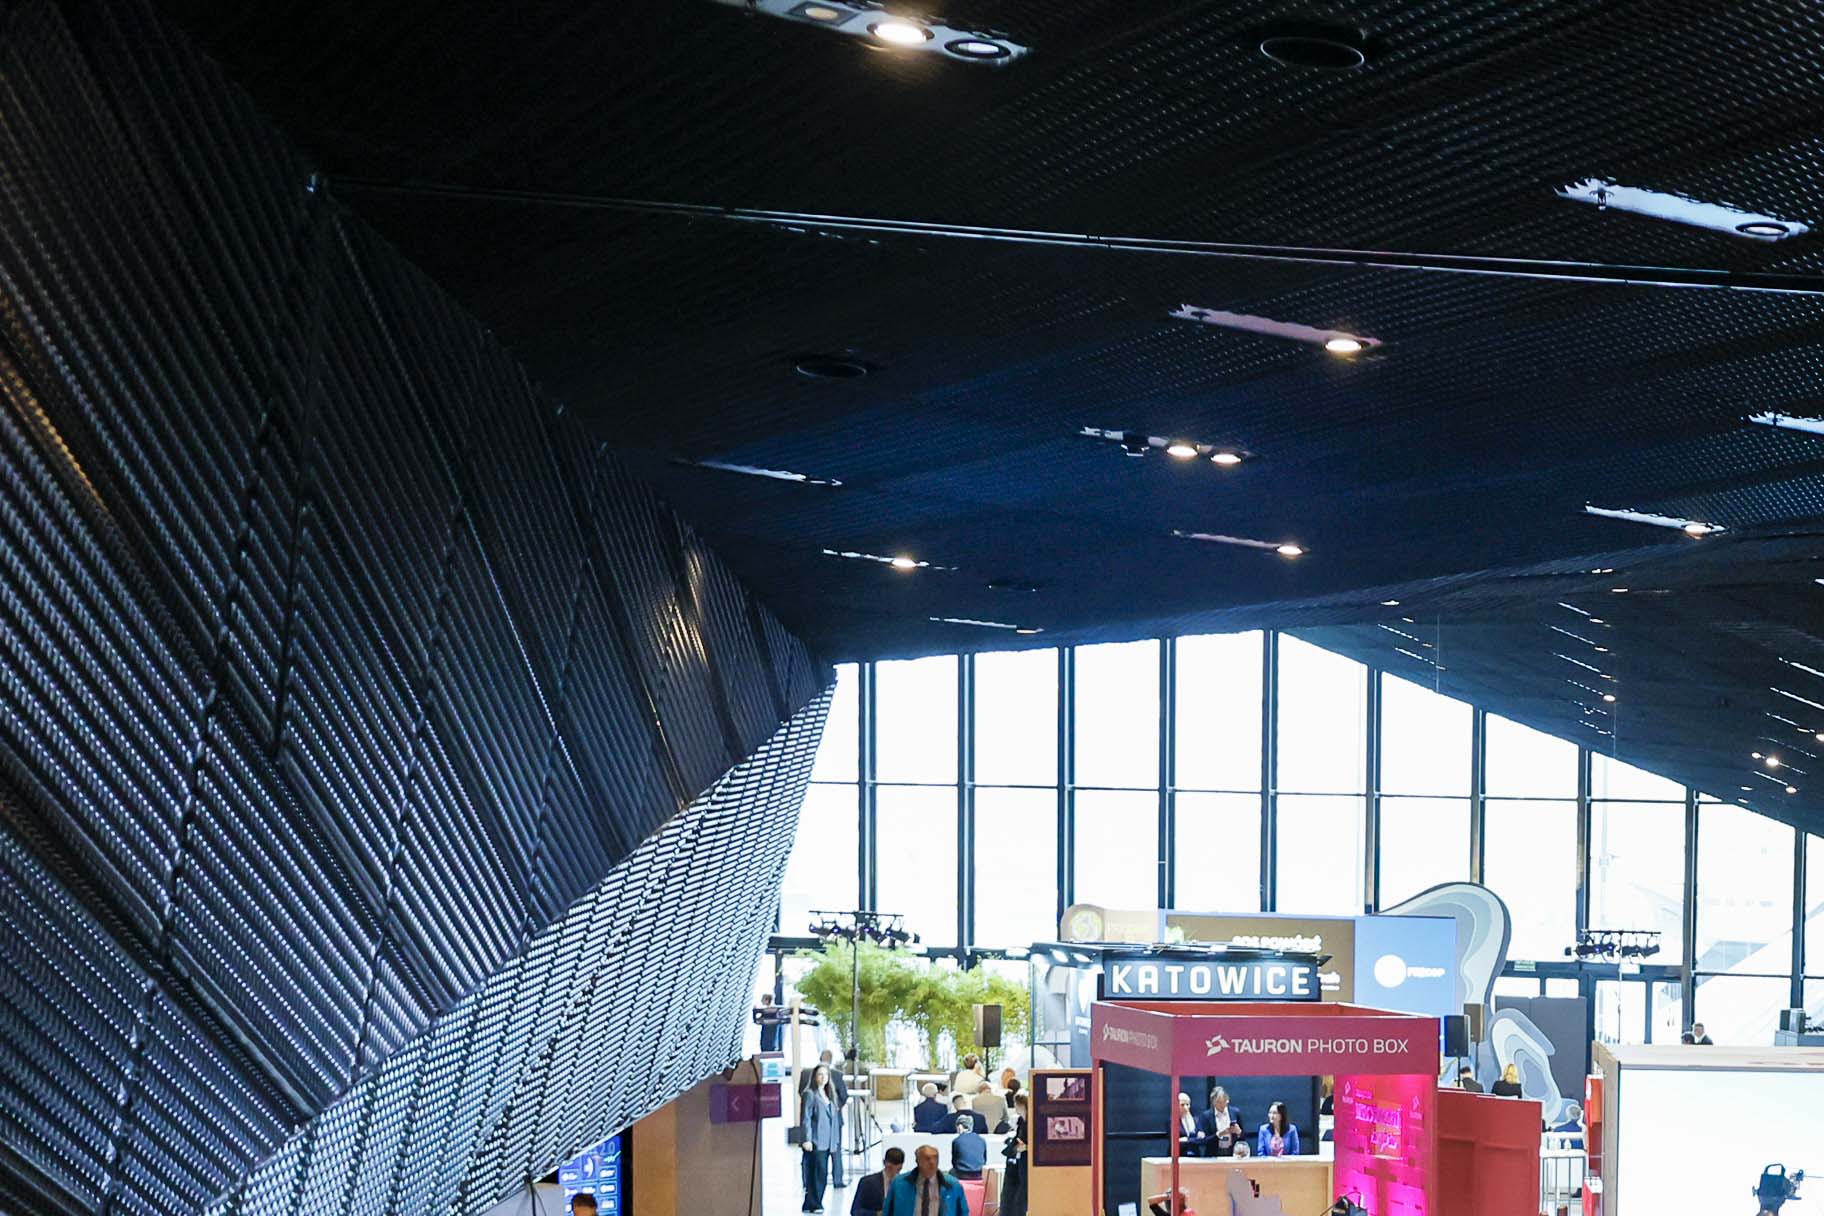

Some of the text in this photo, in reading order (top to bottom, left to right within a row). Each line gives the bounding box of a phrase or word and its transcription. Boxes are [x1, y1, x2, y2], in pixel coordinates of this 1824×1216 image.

[1112, 965, 1311, 995] KATOWICE
[1232, 1038, 1409, 1053] TAURON PHOTO BOX
